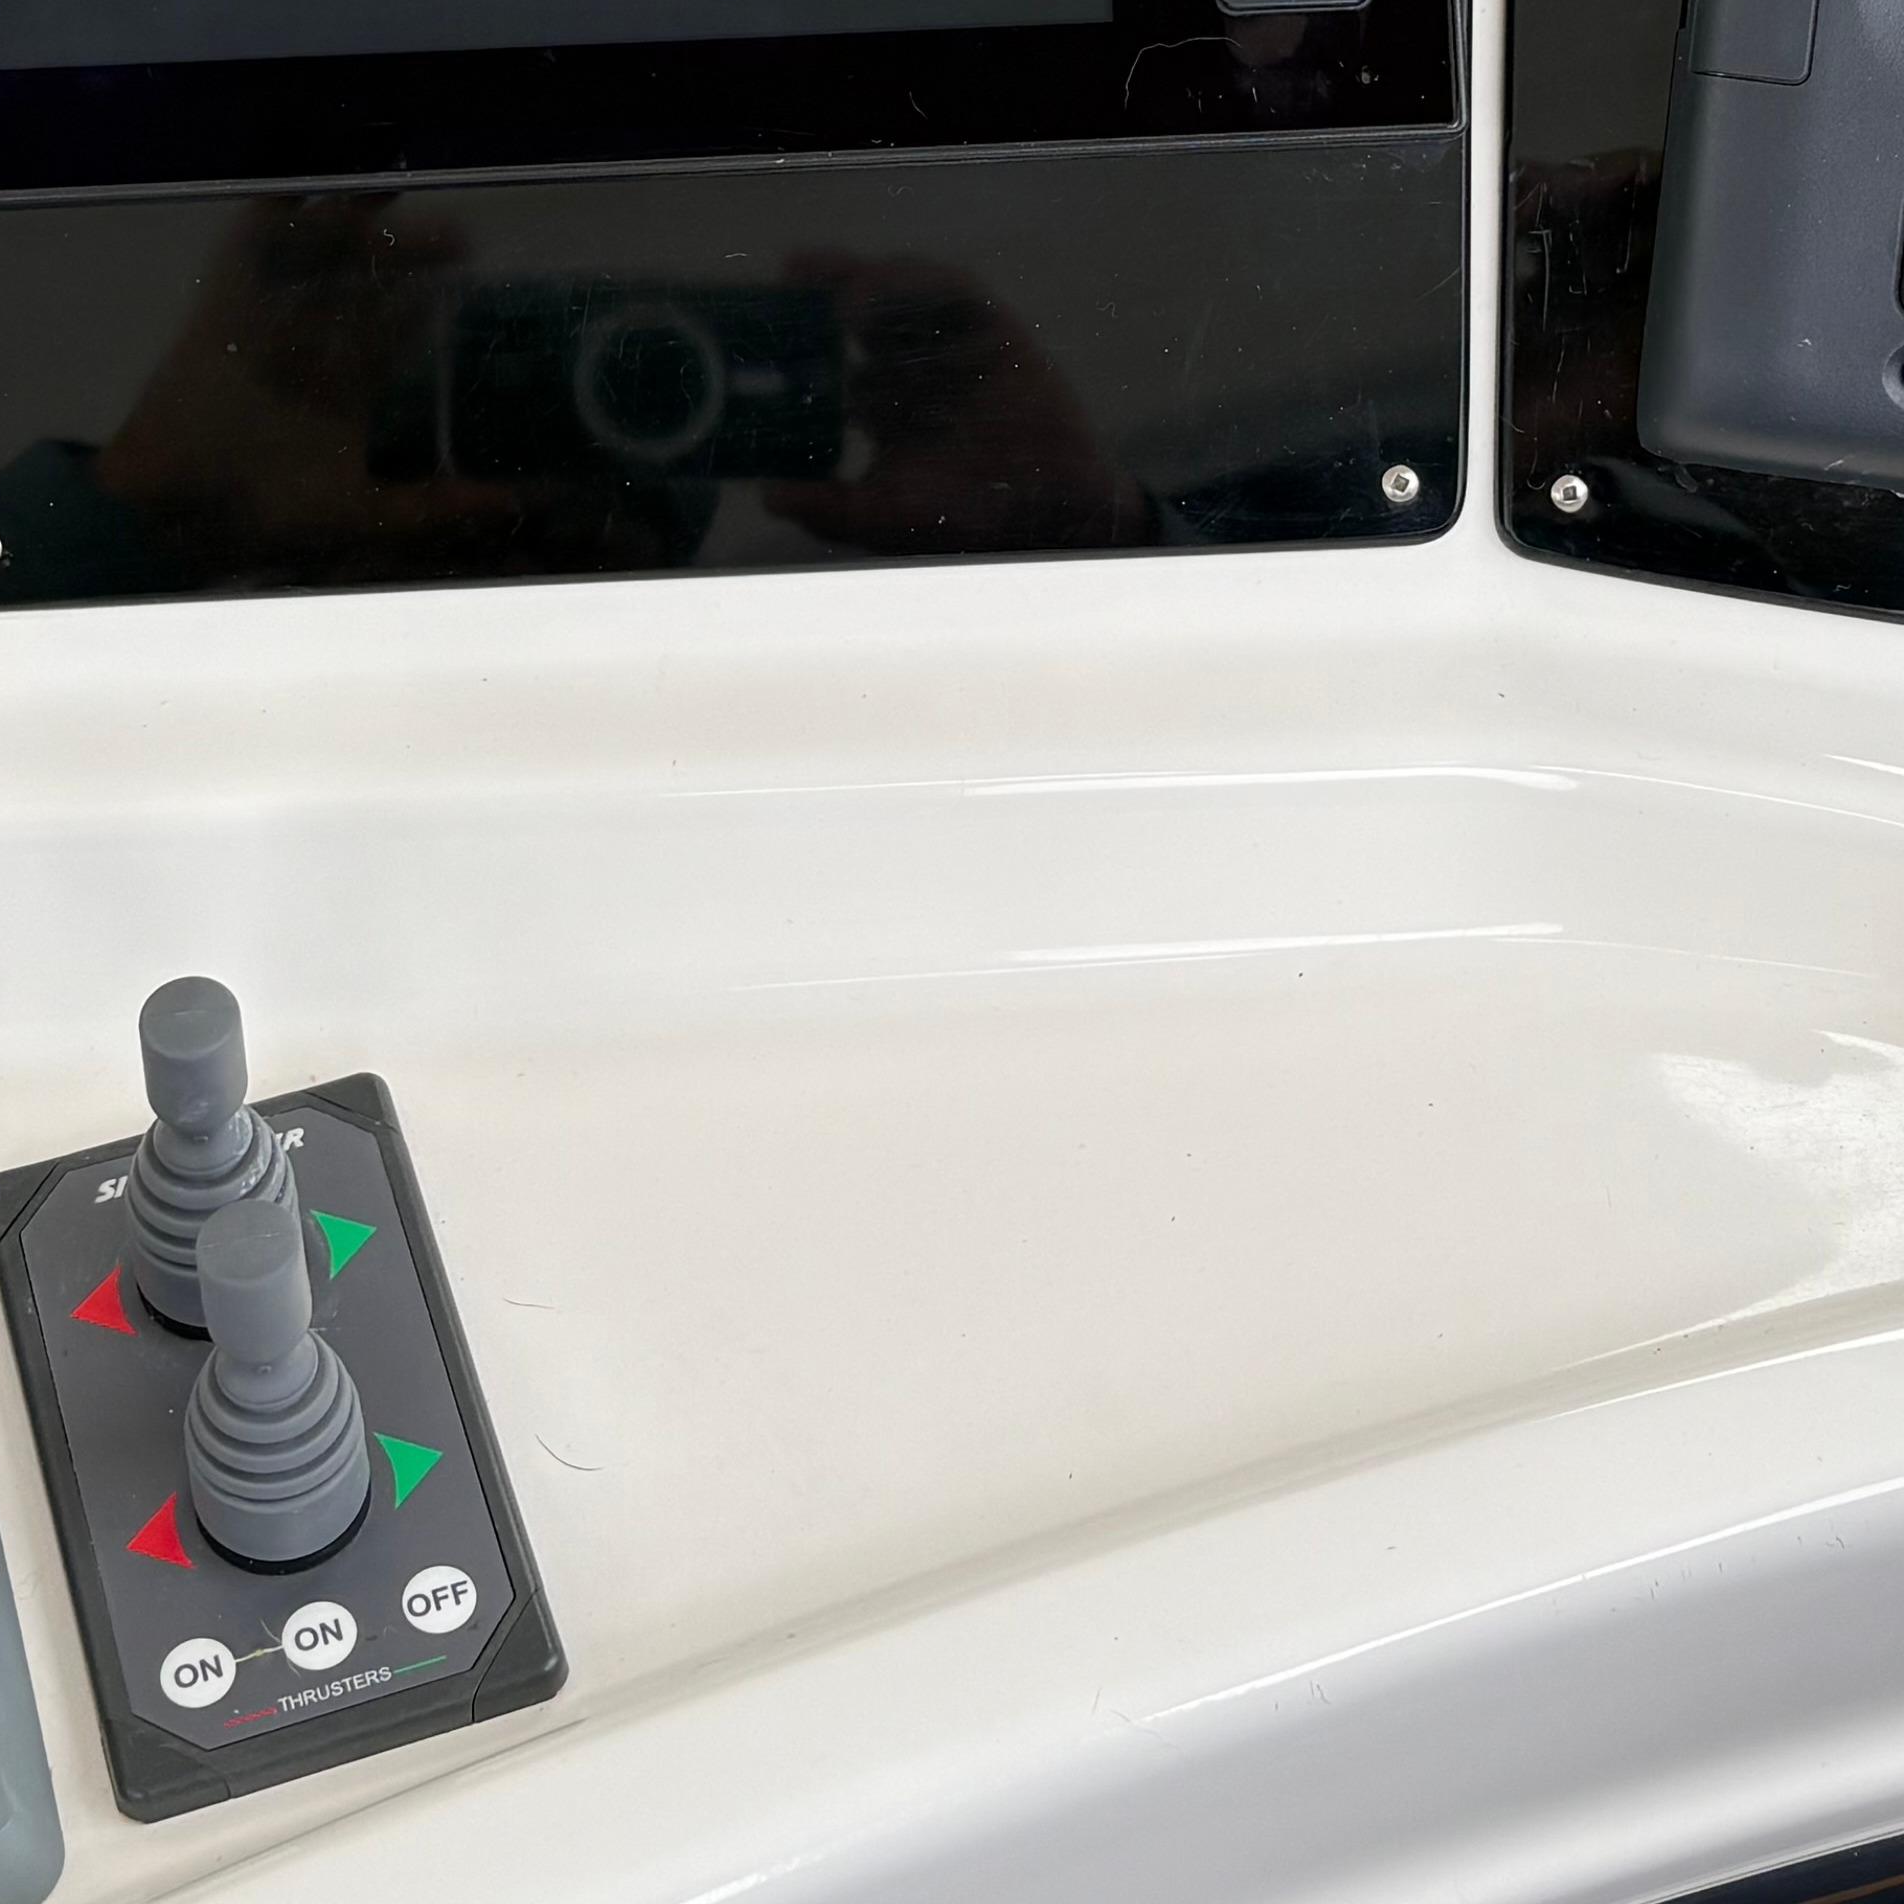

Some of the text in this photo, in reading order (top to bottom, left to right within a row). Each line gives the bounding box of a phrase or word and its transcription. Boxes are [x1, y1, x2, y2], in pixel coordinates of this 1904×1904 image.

[406, 1580, 470, 1618] OFF
[294, 1618, 344, 1652] ON
[173, 1654, 224, 1690] ON
[277, 1666, 393, 1712] THRUSTERS
